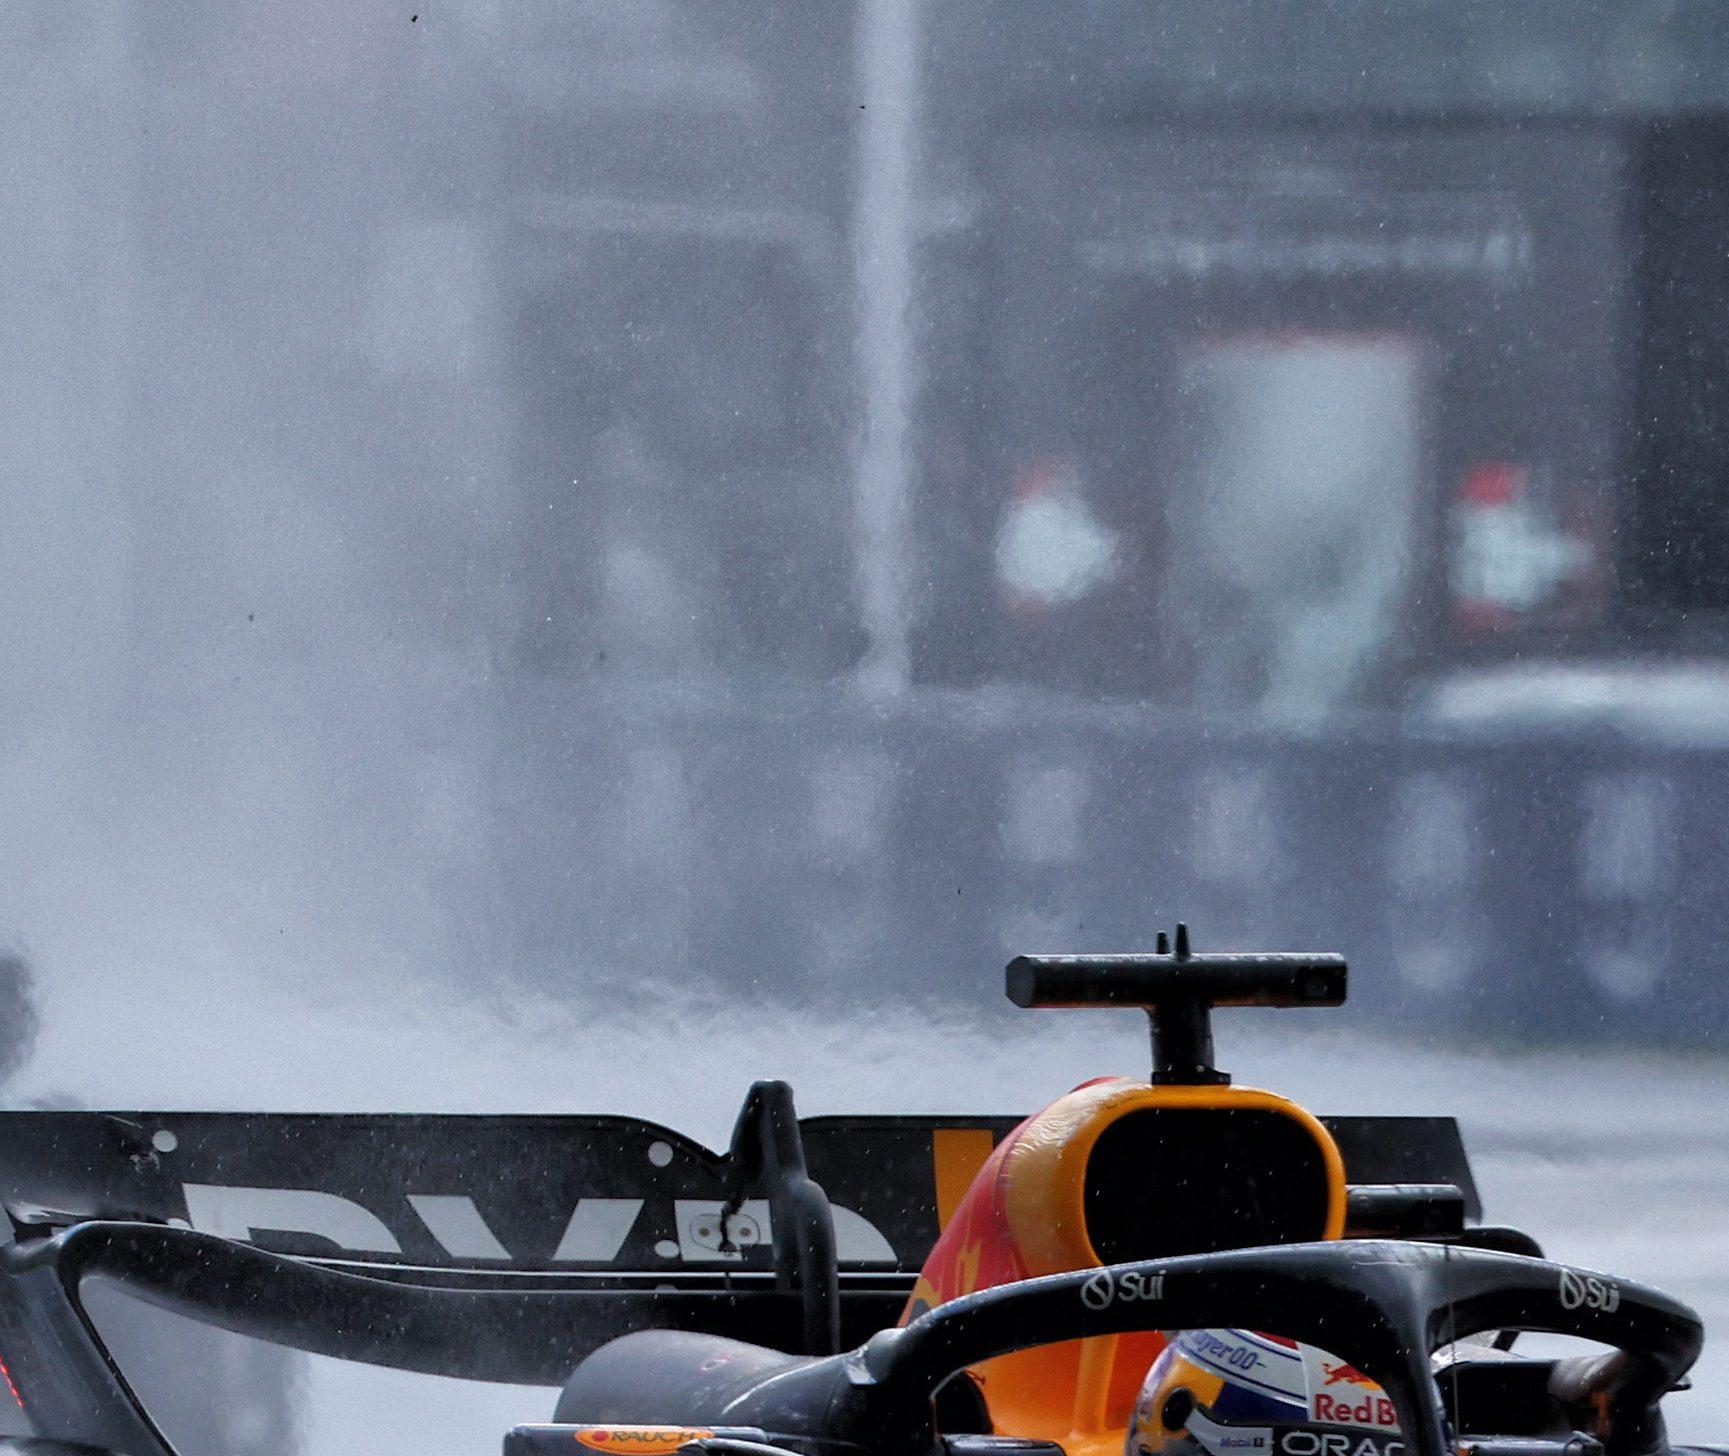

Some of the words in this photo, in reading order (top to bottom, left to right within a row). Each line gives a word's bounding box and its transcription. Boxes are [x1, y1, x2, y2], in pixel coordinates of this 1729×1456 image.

[1118, 1269, 1167, 1302] Sui
[1586, 1277, 1620, 1313] Sui
[1314, 1393, 1372, 1424] Red
[611, 1430, 696, 1443] RAUCH
